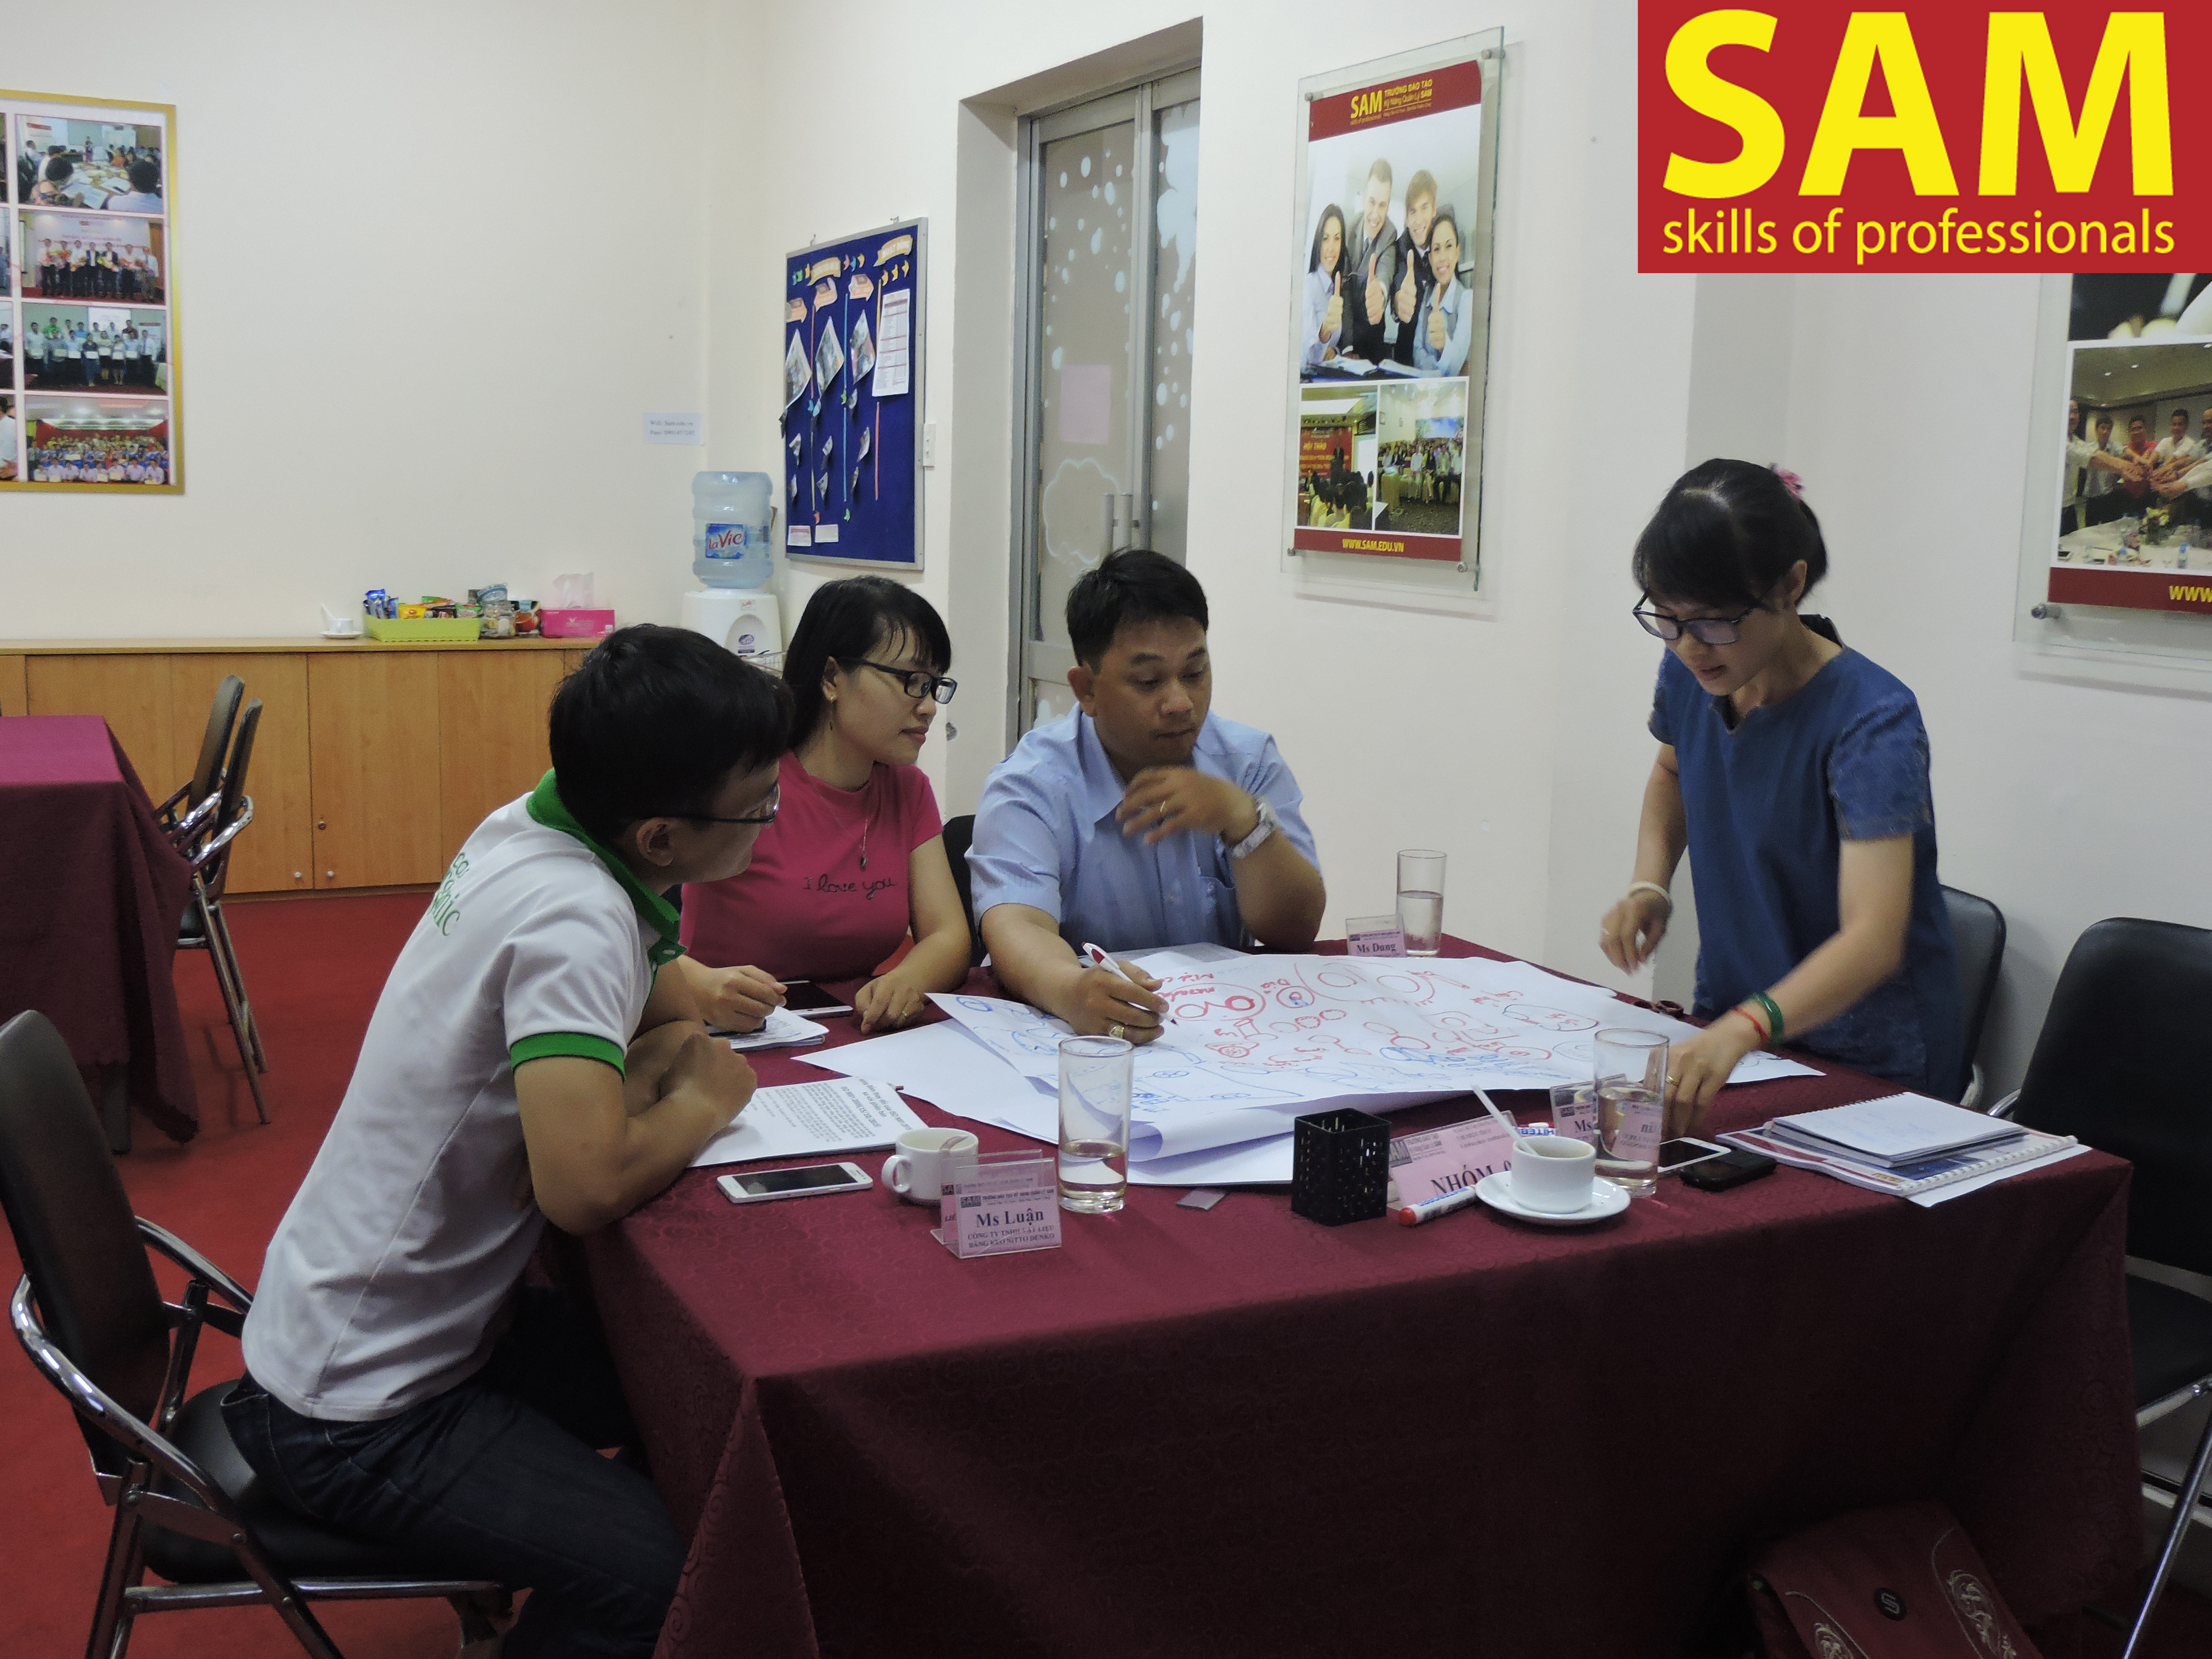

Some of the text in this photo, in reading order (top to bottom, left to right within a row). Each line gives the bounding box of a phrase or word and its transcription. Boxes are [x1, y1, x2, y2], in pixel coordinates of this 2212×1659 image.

[1350, 90, 1382, 119] SAM
[1342, 539, 1404, 552] WWW.SAM.EDU.VN
[817, 873, 857, 892] love
[862, 877, 898, 901] you
[1357, 944, 1370, 953] Ms
[1575, 1119, 1593, 1133] Ms
[976, 1208, 1044, 1227] Ms Luận
